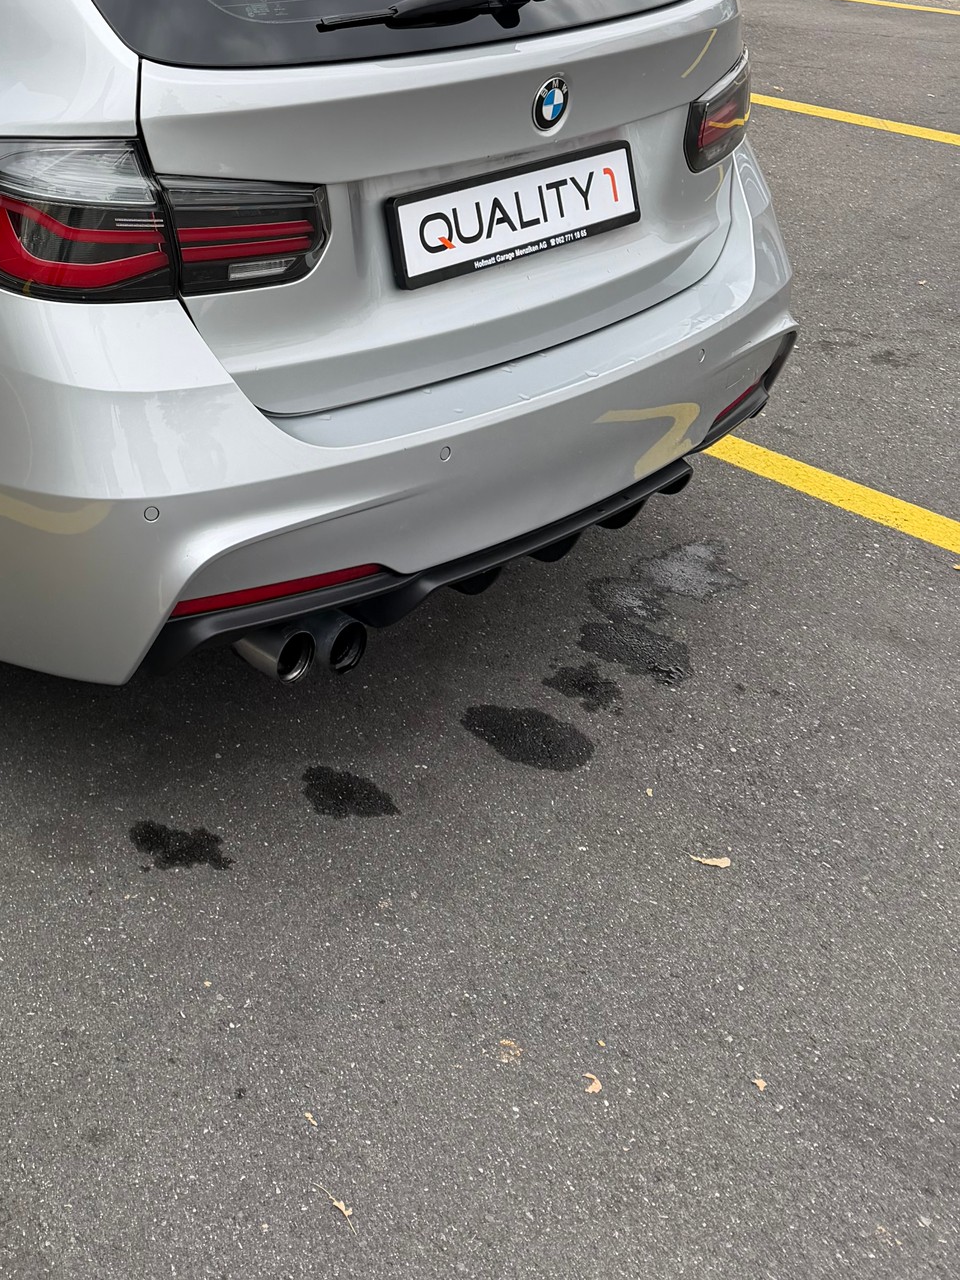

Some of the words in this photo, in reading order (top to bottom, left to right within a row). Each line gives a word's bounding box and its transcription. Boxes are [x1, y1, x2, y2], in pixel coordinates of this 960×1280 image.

[540, 79, 568, 98] BMW
[419, 171, 594, 254] QUALITY
[602, 167, 619, 203] 1
[496, 251, 515, 261] Garage
[539, 240, 548, 249] AG
[565, 233, 574, 242] 771
